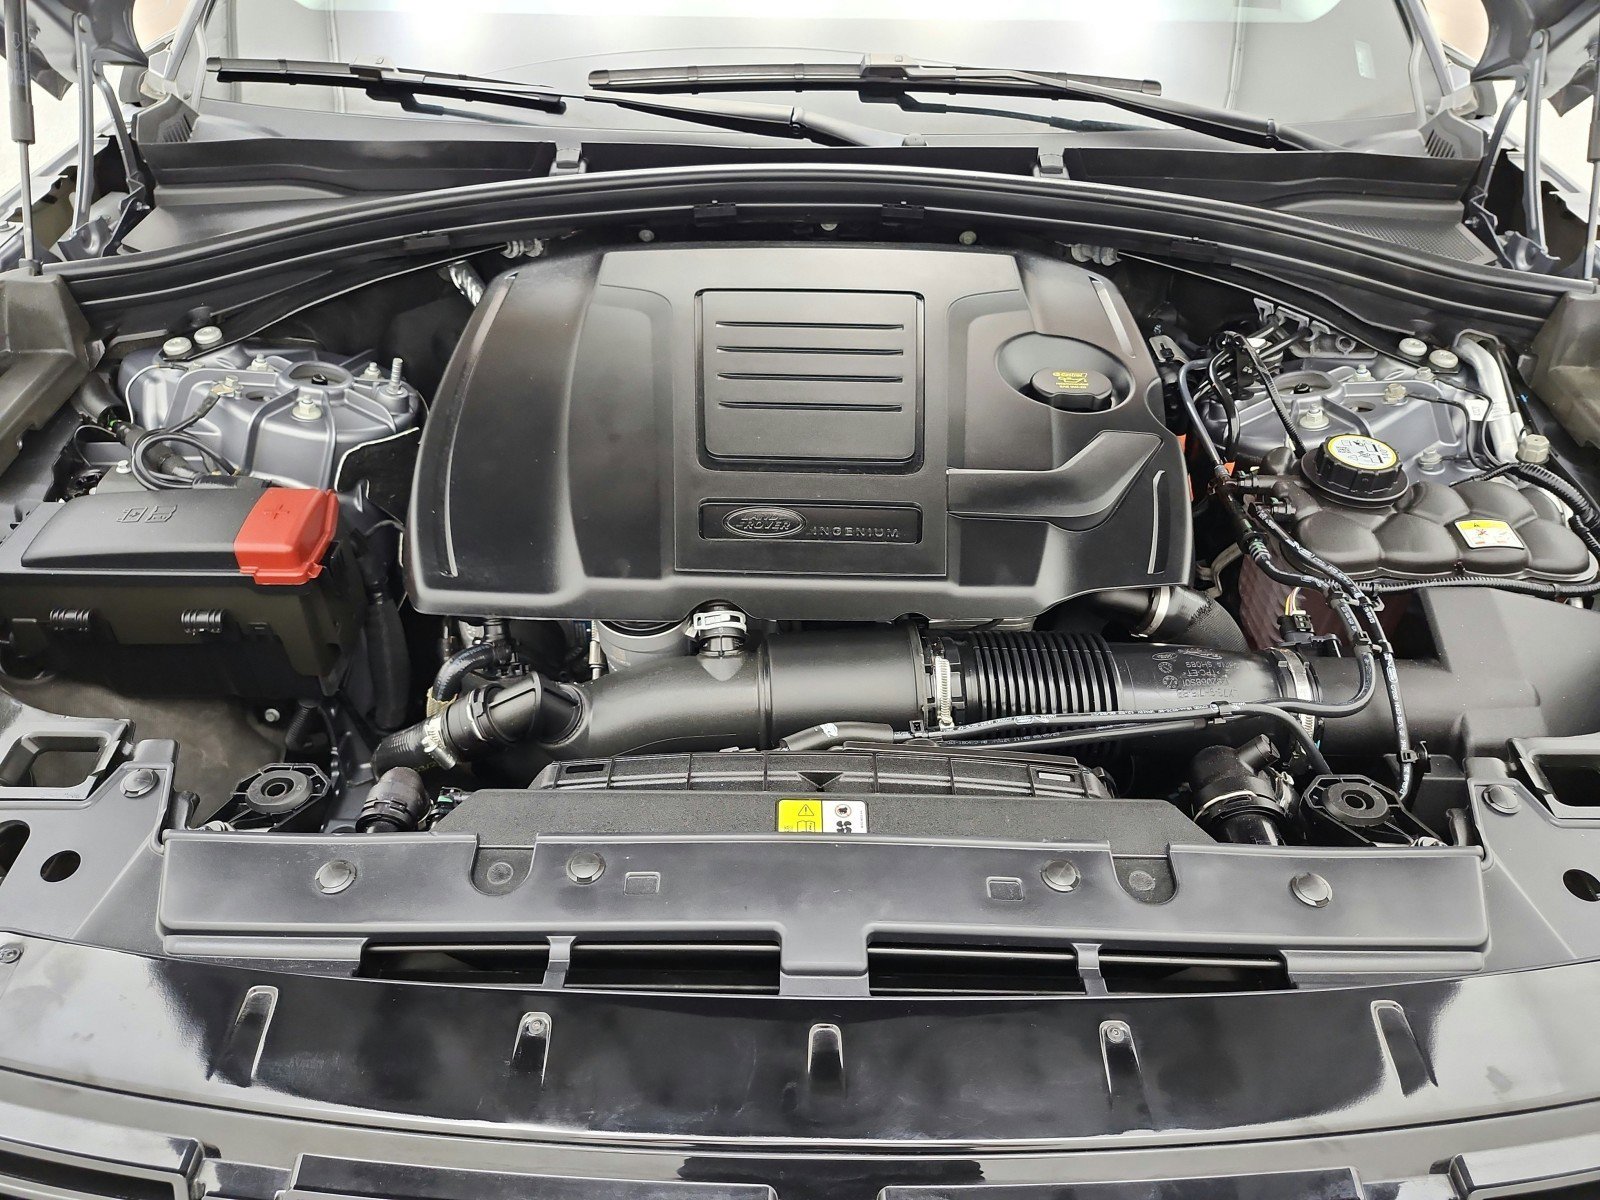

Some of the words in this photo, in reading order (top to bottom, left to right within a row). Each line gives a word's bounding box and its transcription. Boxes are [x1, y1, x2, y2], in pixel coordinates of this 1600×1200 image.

[741, 513, 781, 522] LAND
[740, 520, 791, 530] ROVER
[808, 525, 899, 538] INGENIUM
